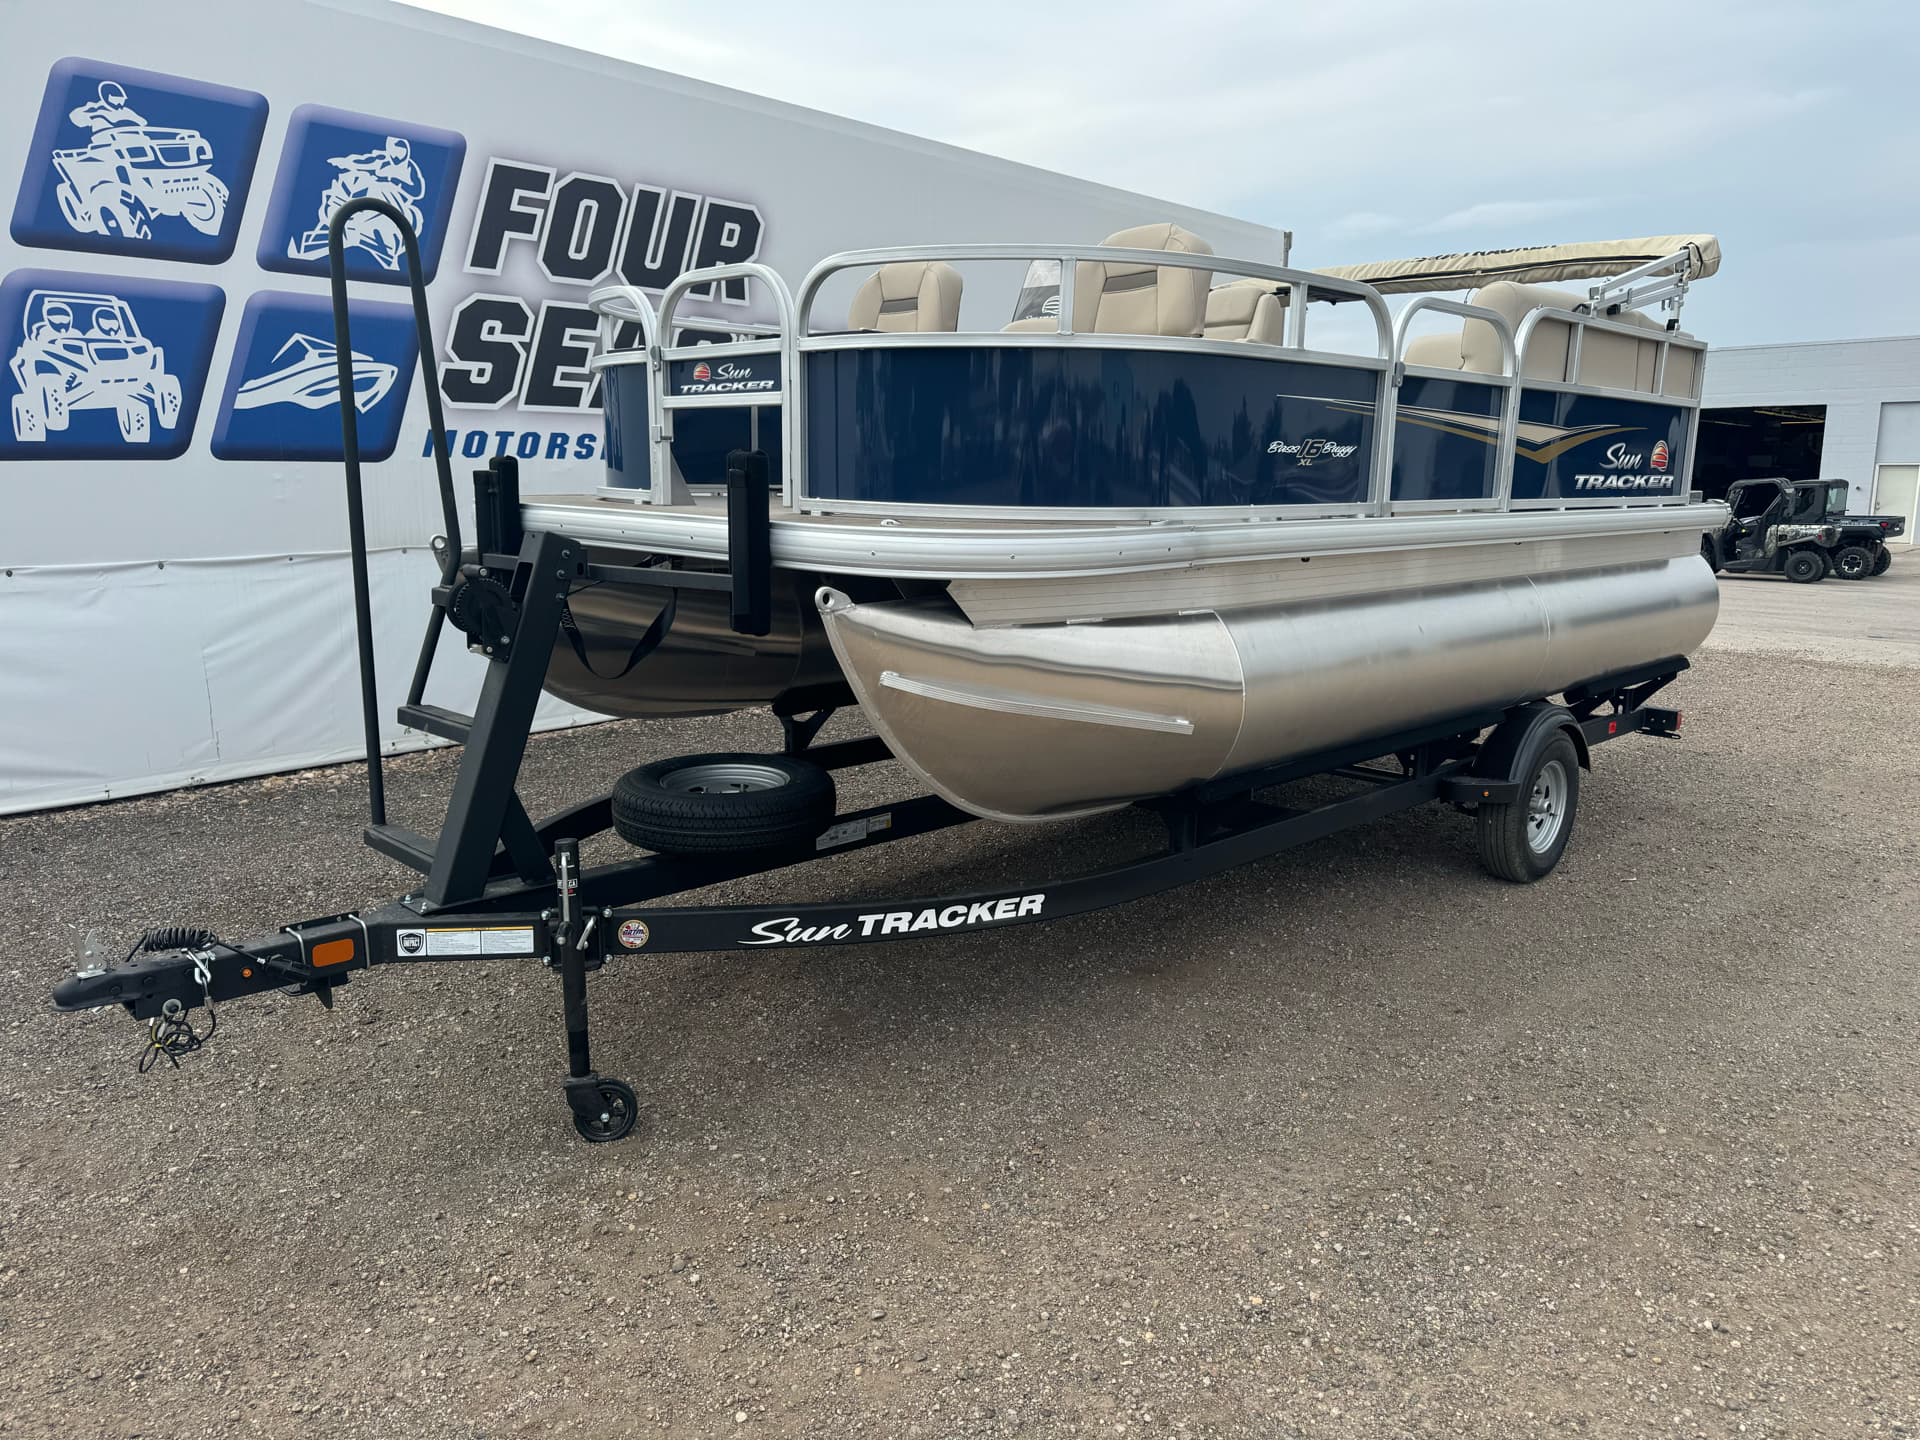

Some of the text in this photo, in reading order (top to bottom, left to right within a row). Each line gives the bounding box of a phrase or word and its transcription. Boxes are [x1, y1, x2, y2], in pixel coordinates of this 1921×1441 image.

[464, 157, 765, 305] FOUR
[712, 363, 752, 380] Sun
[680, 380, 775, 394] TRACKER
[422, 429, 607, 460] MOTORS
[1267, 438, 1358, 458] Bass 16 Buggy
[1297, 458, 1313, 466] XL
[1600, 442, 1643, 470] Sun
[1574, 474, 1674, 490] TRACKER
[736, 893, 1045, 945] Sun TRACKER
